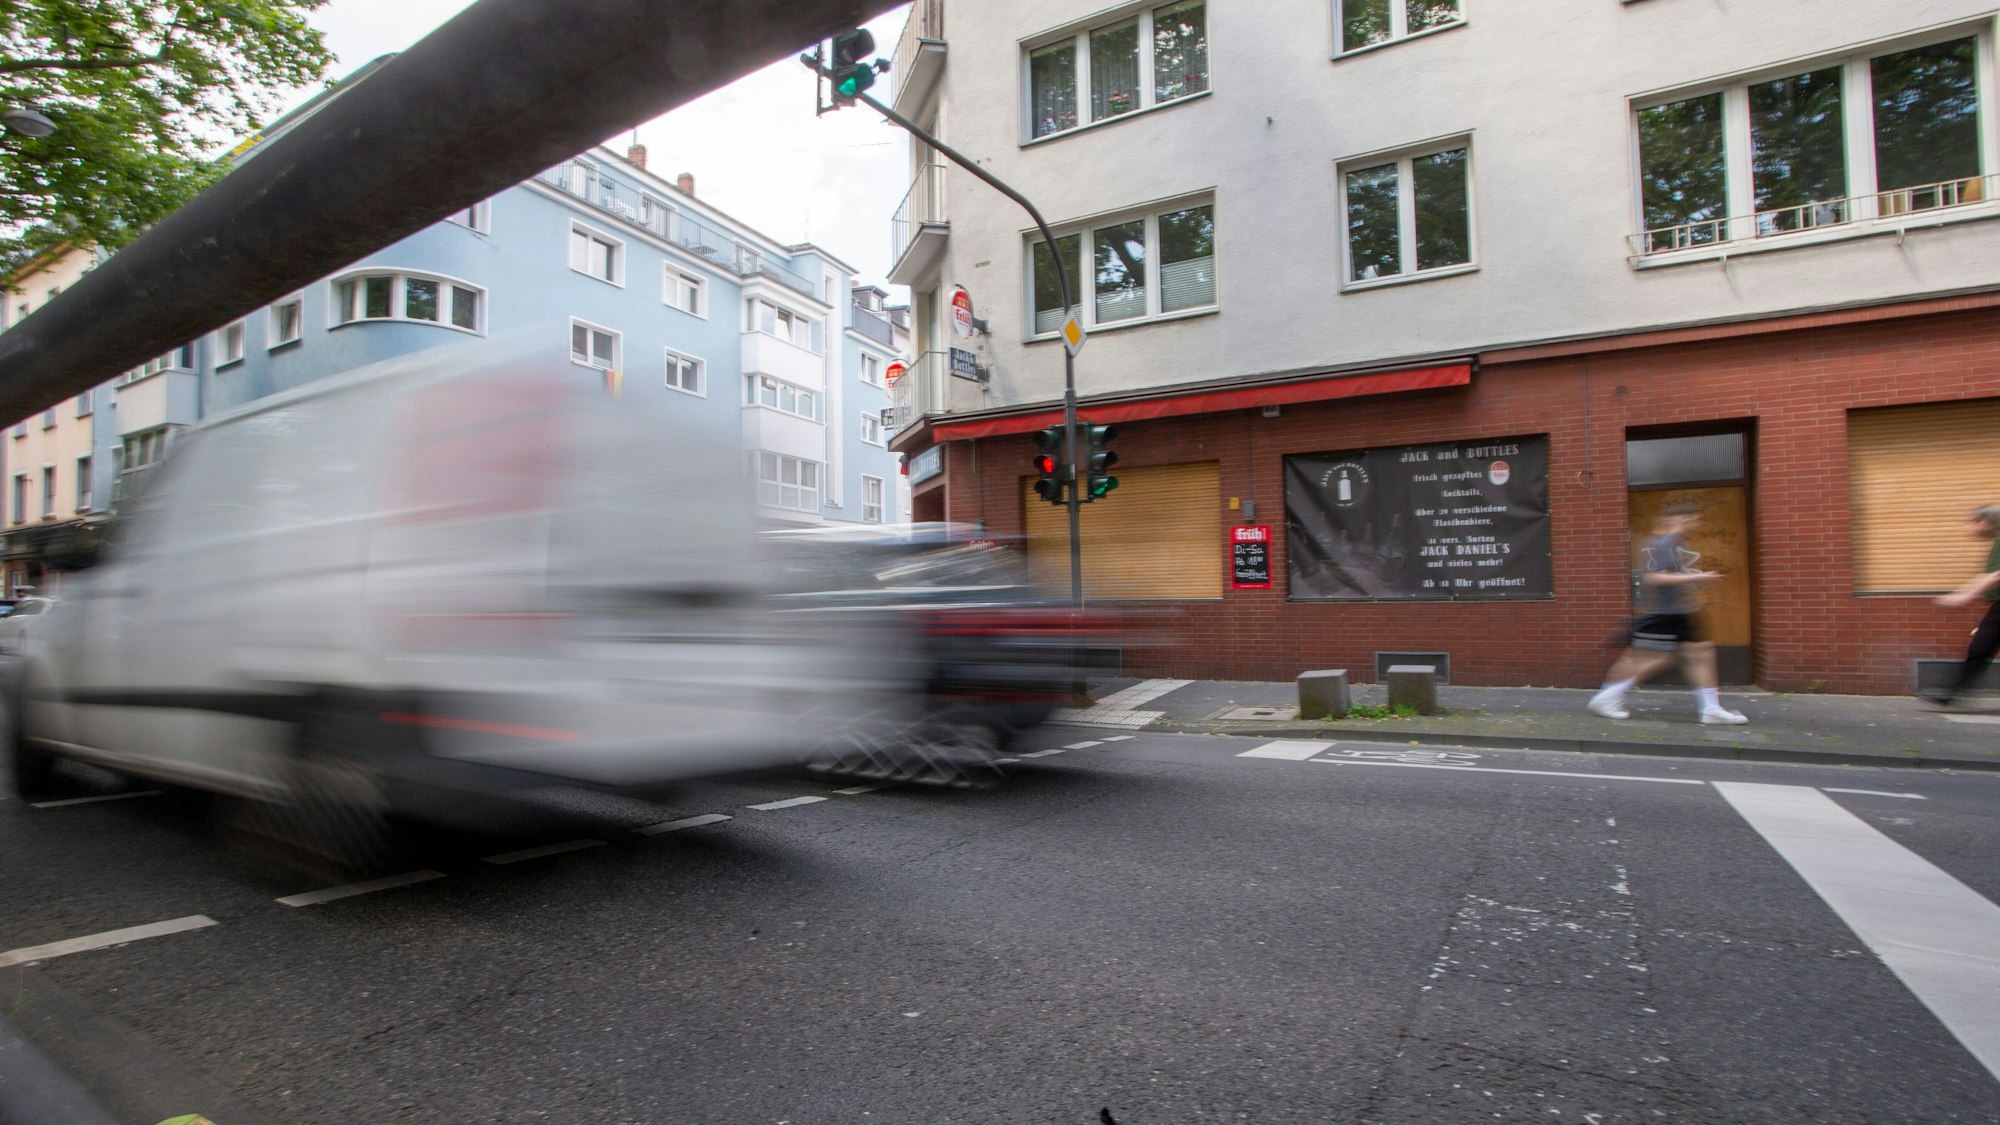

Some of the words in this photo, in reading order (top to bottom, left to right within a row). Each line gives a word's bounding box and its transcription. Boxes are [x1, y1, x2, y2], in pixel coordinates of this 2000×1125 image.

[1400, 451, 1429, 463] JACK
[1437, 448, 1458, 460] and
[1467, 444, 1519, 459] BOTTLES
[1414, 473, 1438, 482] frisch
[1443, 471, 1483, 482] gezapftes
[1442, 488, 1483, 497] Cocktails,
[1454, 505, 1507, 514] verschiedene
[1434, 517, 1493, 527] Flaschenbiere,
[1467, 535, 1495, 543] Sorten
[1420, 545, 1449, 556] JACK
[1428, 560, 1443, 568] und
[1448, 559, 1472, 567] vieles
[1477, 558, 1503, 567] mehr!
[1424, 579, 1435, 588] Ab
[1455, 578, 1473, 587] Uhr
[1480, 577, 1525, 589] geöffnet!
